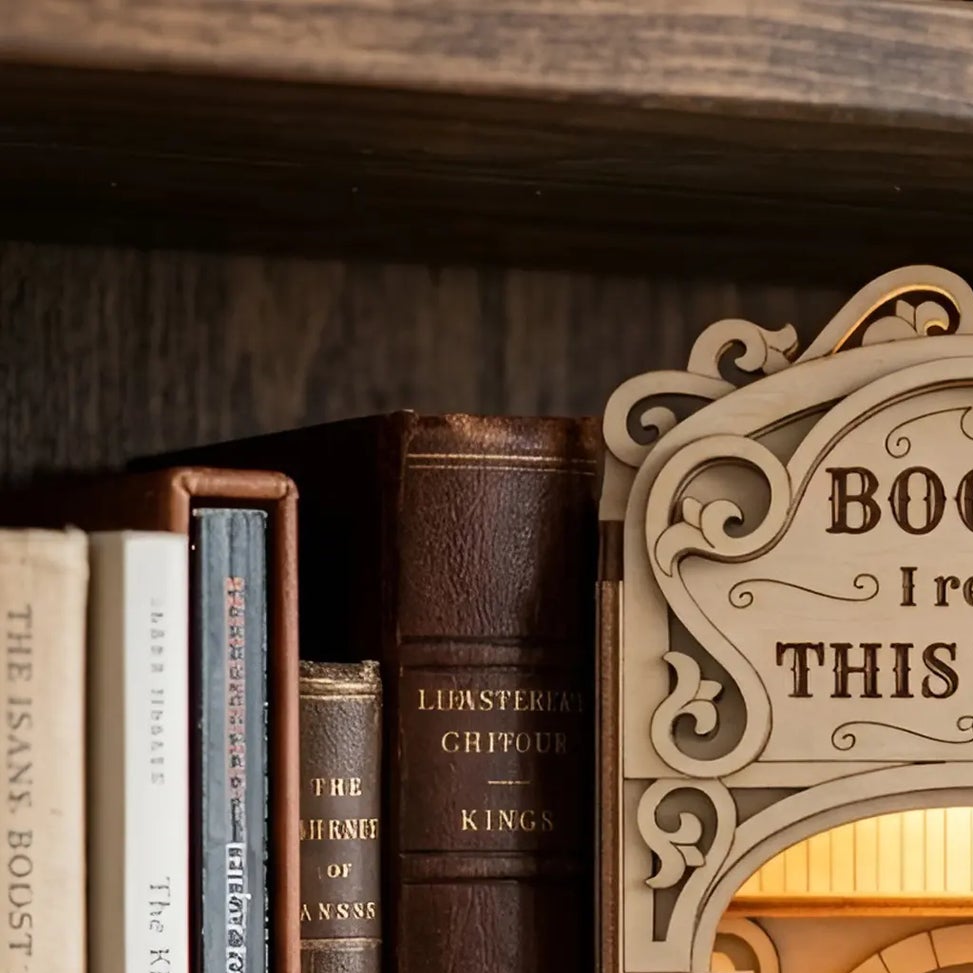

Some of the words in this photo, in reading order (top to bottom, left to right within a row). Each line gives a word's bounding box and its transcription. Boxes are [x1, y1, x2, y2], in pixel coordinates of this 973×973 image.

[900, 566, 918, 608] I
[8, 603, 34, 681] THE
[776, 641, 960, 699] THIS
[311, 777, 362, 797] THE
[461, 809, 555, 832] KINGS
[326, 862, 353, 878] OF
